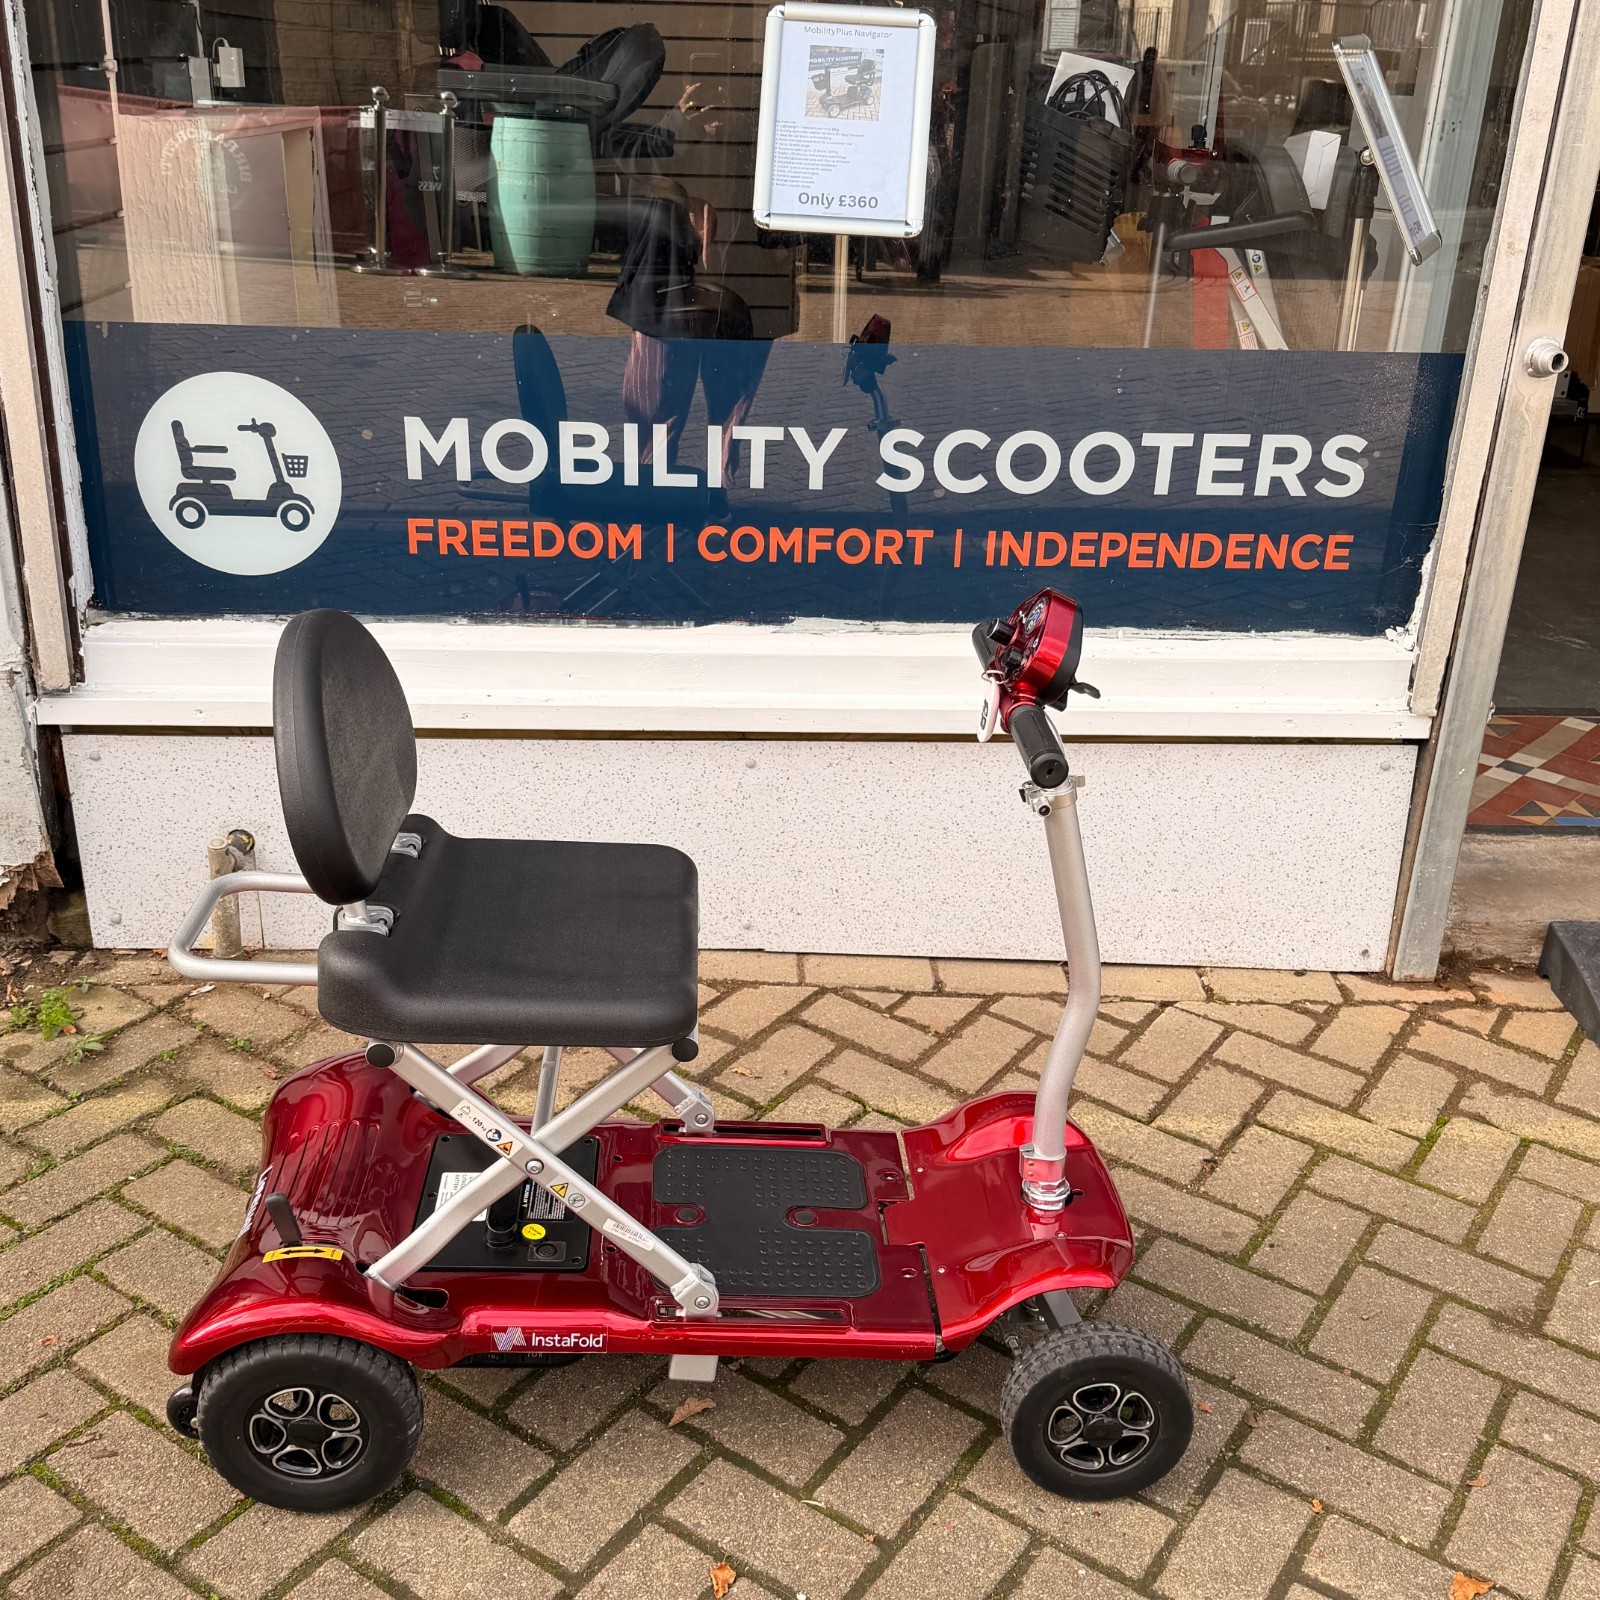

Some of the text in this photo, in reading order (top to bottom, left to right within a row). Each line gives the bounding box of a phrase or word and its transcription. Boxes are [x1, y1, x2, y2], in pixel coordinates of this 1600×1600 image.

[803, 26, 893, 39] MobilityPlus Navigator
[798, 192, 879, 210] Only £360
[403, 415, 1369, 498] MOBILITY SCOOTERS
[407, 518, 643, 560] FREEDOM
[698, 525, 934, 567] COMFORT
[985, 530, 1355, 571] INDEPENDENCE
[531, 1332, 603, 1348] InstaFold
